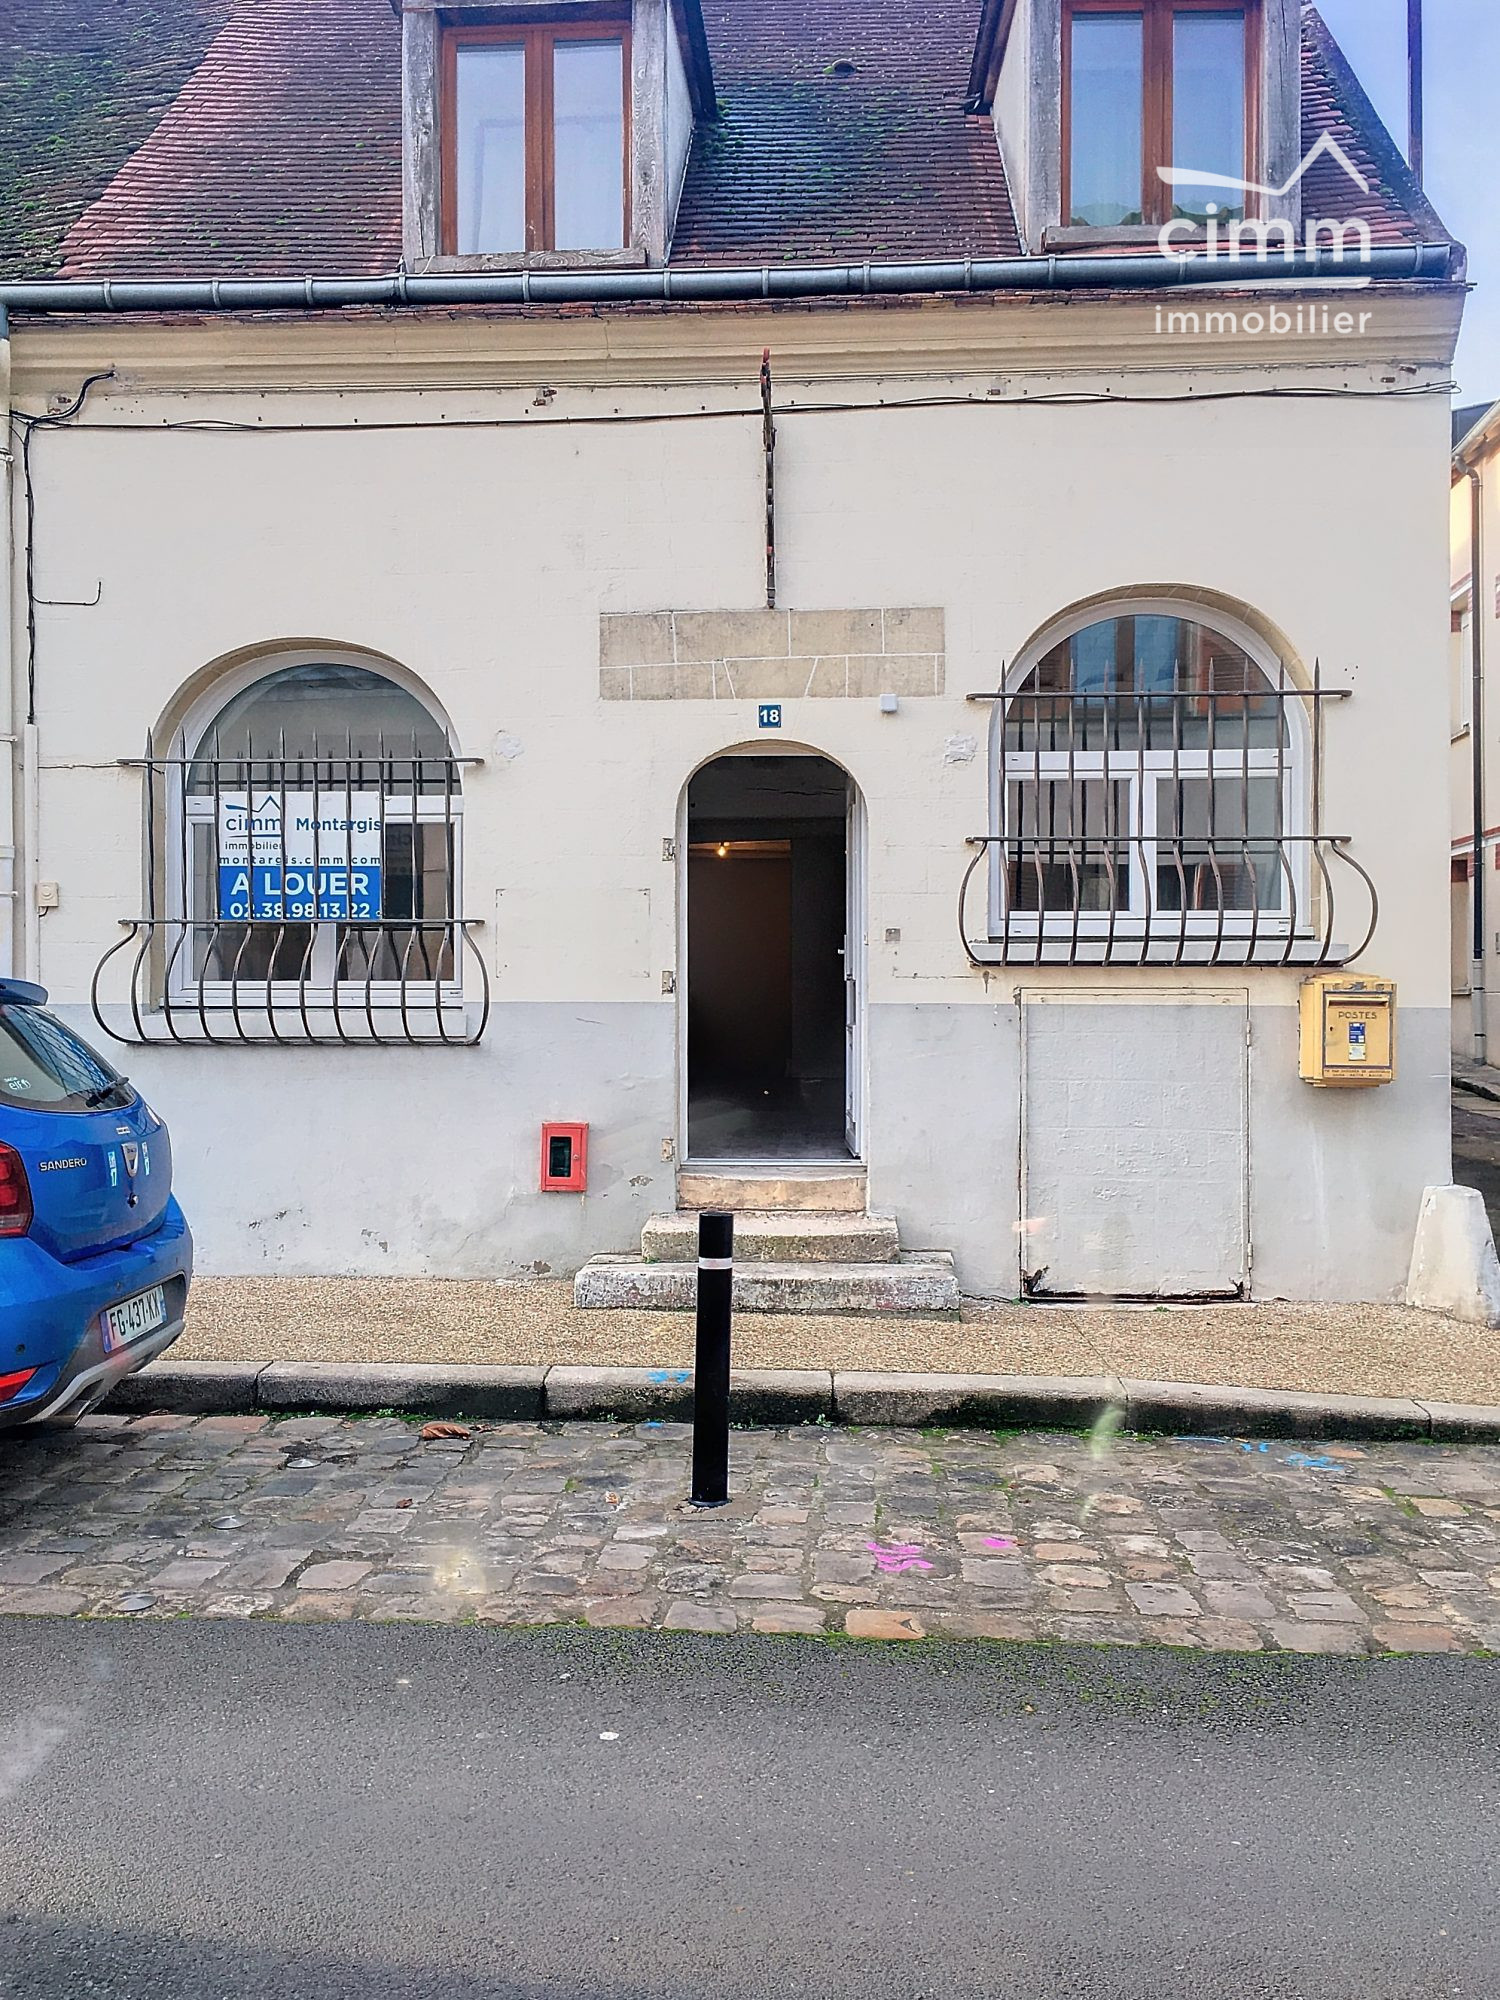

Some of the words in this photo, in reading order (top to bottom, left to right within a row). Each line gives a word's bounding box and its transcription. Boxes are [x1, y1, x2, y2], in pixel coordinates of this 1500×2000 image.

[760, 709, 780, 723] 18
[226, 815, 282, 831] cimm
[296, 816, 384, 834] Montargis
[230, 872, 252, 895] A
[264, 872, 369, 895] LOUER
[1338, 1011, 1377, 1020] POSTES
[40, 1157, 87, 1171] SANDERO
